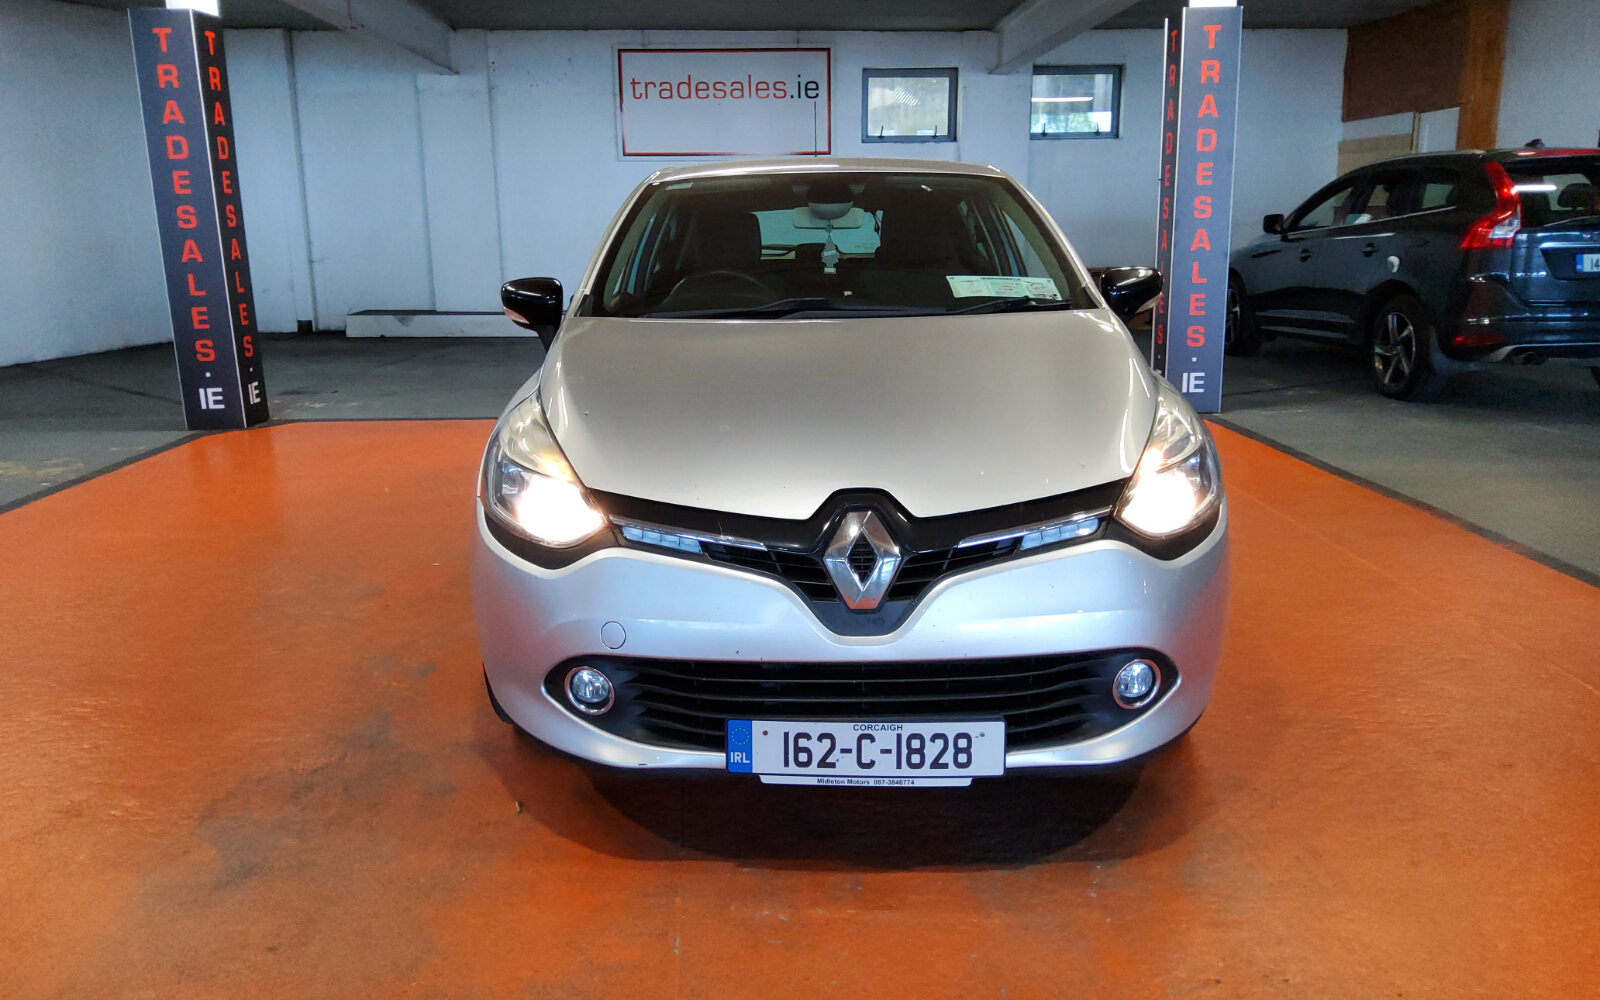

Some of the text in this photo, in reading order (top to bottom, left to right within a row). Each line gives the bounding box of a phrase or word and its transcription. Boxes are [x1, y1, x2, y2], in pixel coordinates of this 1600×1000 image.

[630, 74, 819, 99] tradesales.ie
[853, 723, 903, 731] CORCAIGH
[730, 752, 750, 764] IRL
[784, 731, 972, 769] 162-C-1828
